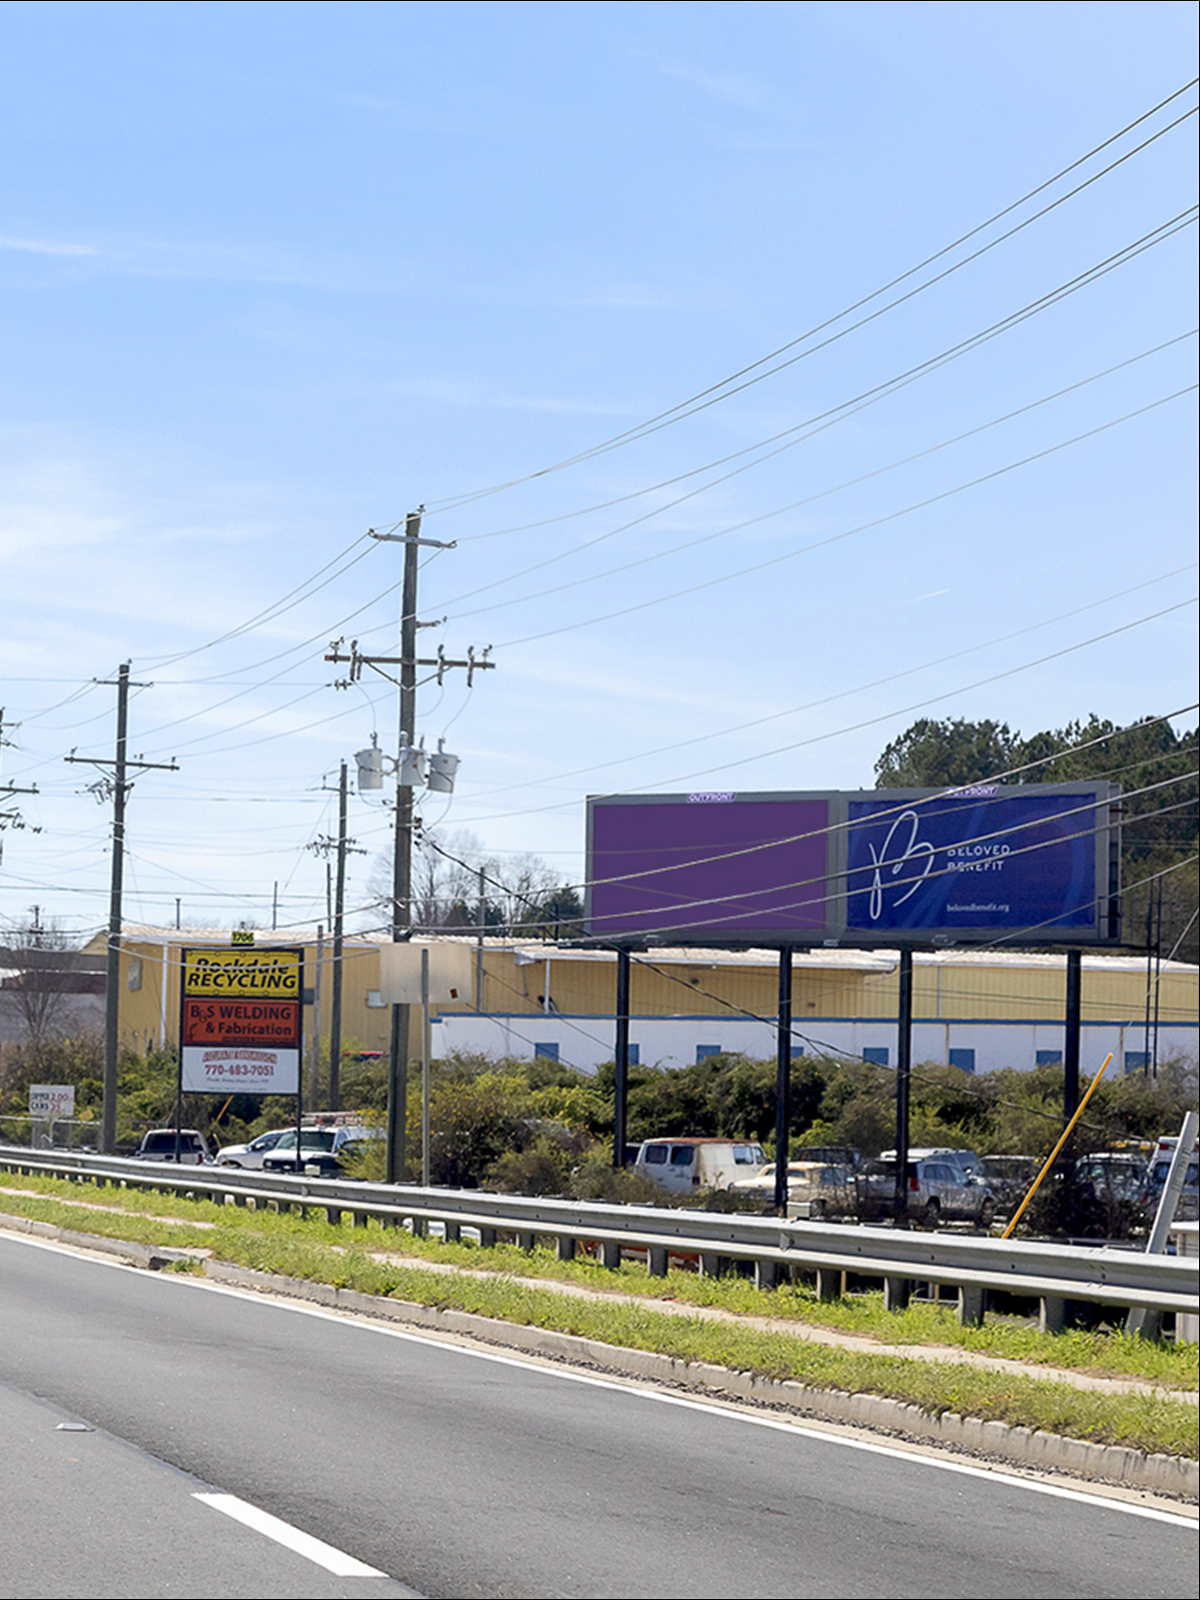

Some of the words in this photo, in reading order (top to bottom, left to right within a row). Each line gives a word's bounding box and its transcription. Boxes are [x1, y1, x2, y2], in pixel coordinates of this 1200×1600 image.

[947, 845, 1010, 857] BELOVED
[196, 958, 290, 974] Rockdale
[188, 973, 296, 989] RECYCLING
[219, 1006, 291, 1020] WELDING
[205, 1022, 215, 1034] &
[218, 1022, 292, 1036] Fabrication
[204, 1064, 275, 1076] 770-483-7051
